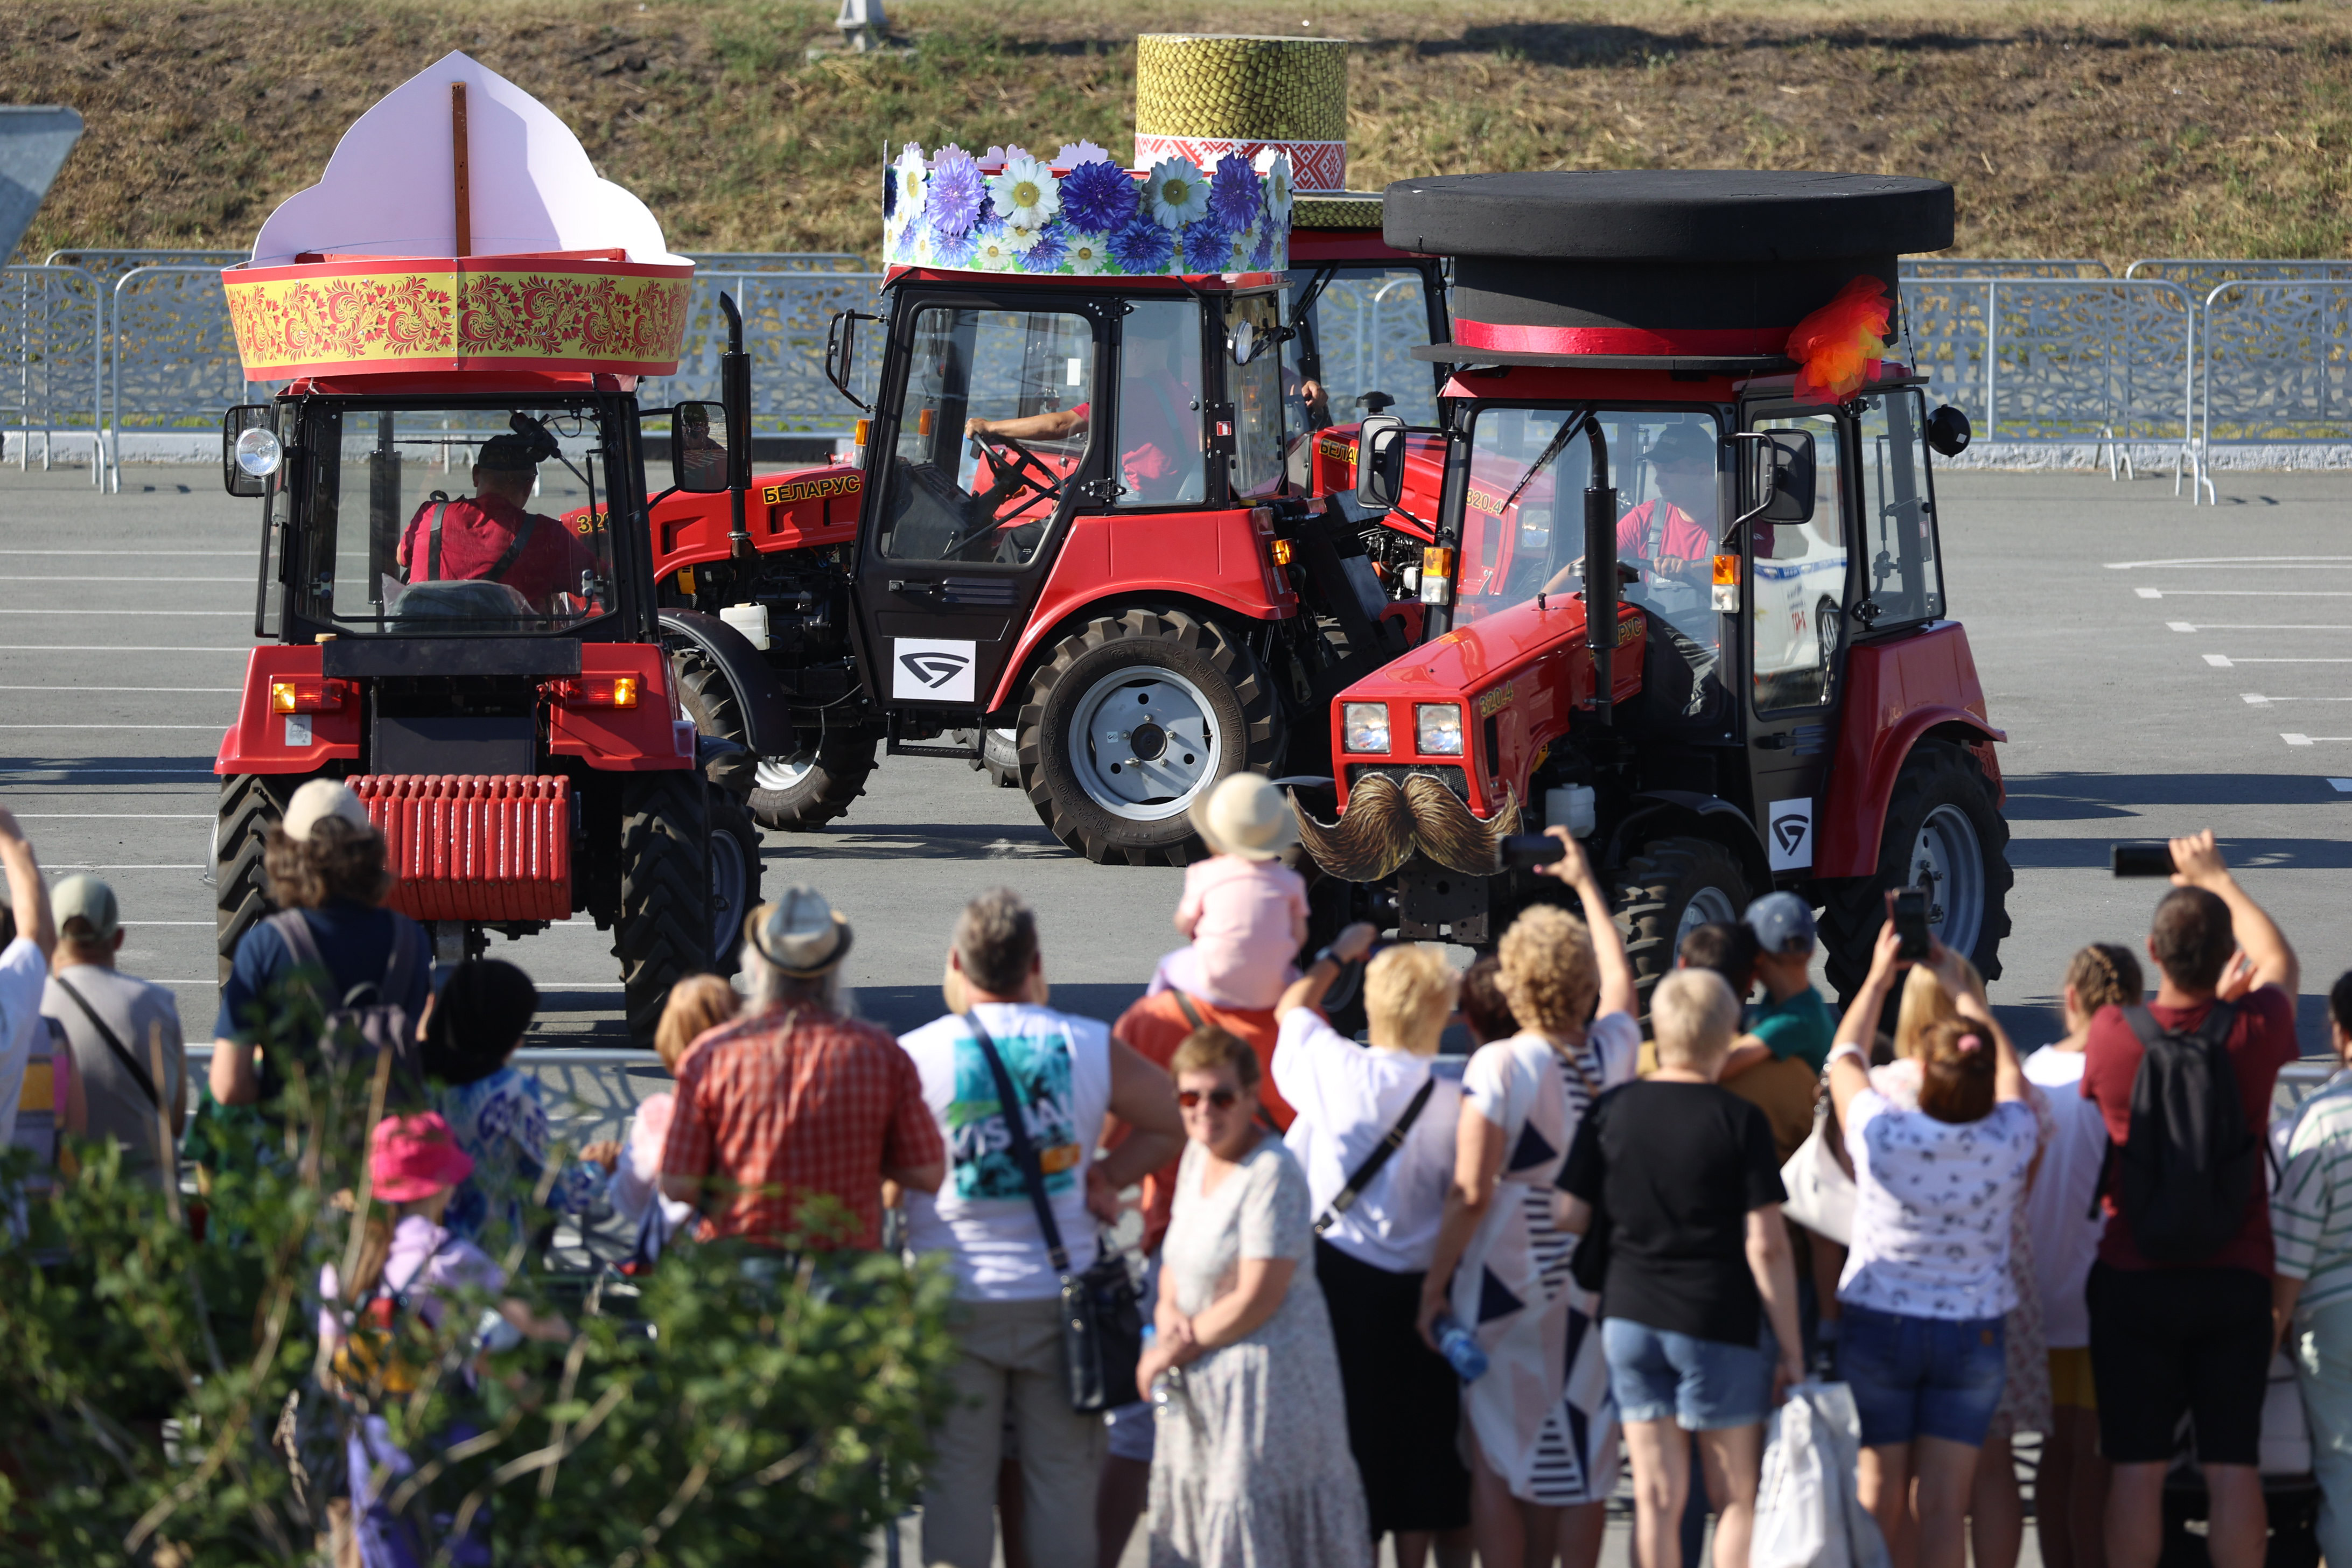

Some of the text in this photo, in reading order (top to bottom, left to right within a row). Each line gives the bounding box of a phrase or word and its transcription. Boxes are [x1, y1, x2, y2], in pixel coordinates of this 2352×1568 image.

[1319, 438, 1358, 465] БЕЛА
[762, 475, 861, 505] БЕЛАРУС
[1466, 488, 1504, 516] 320.4
[1479, 680, 1514, 717] 320.4
